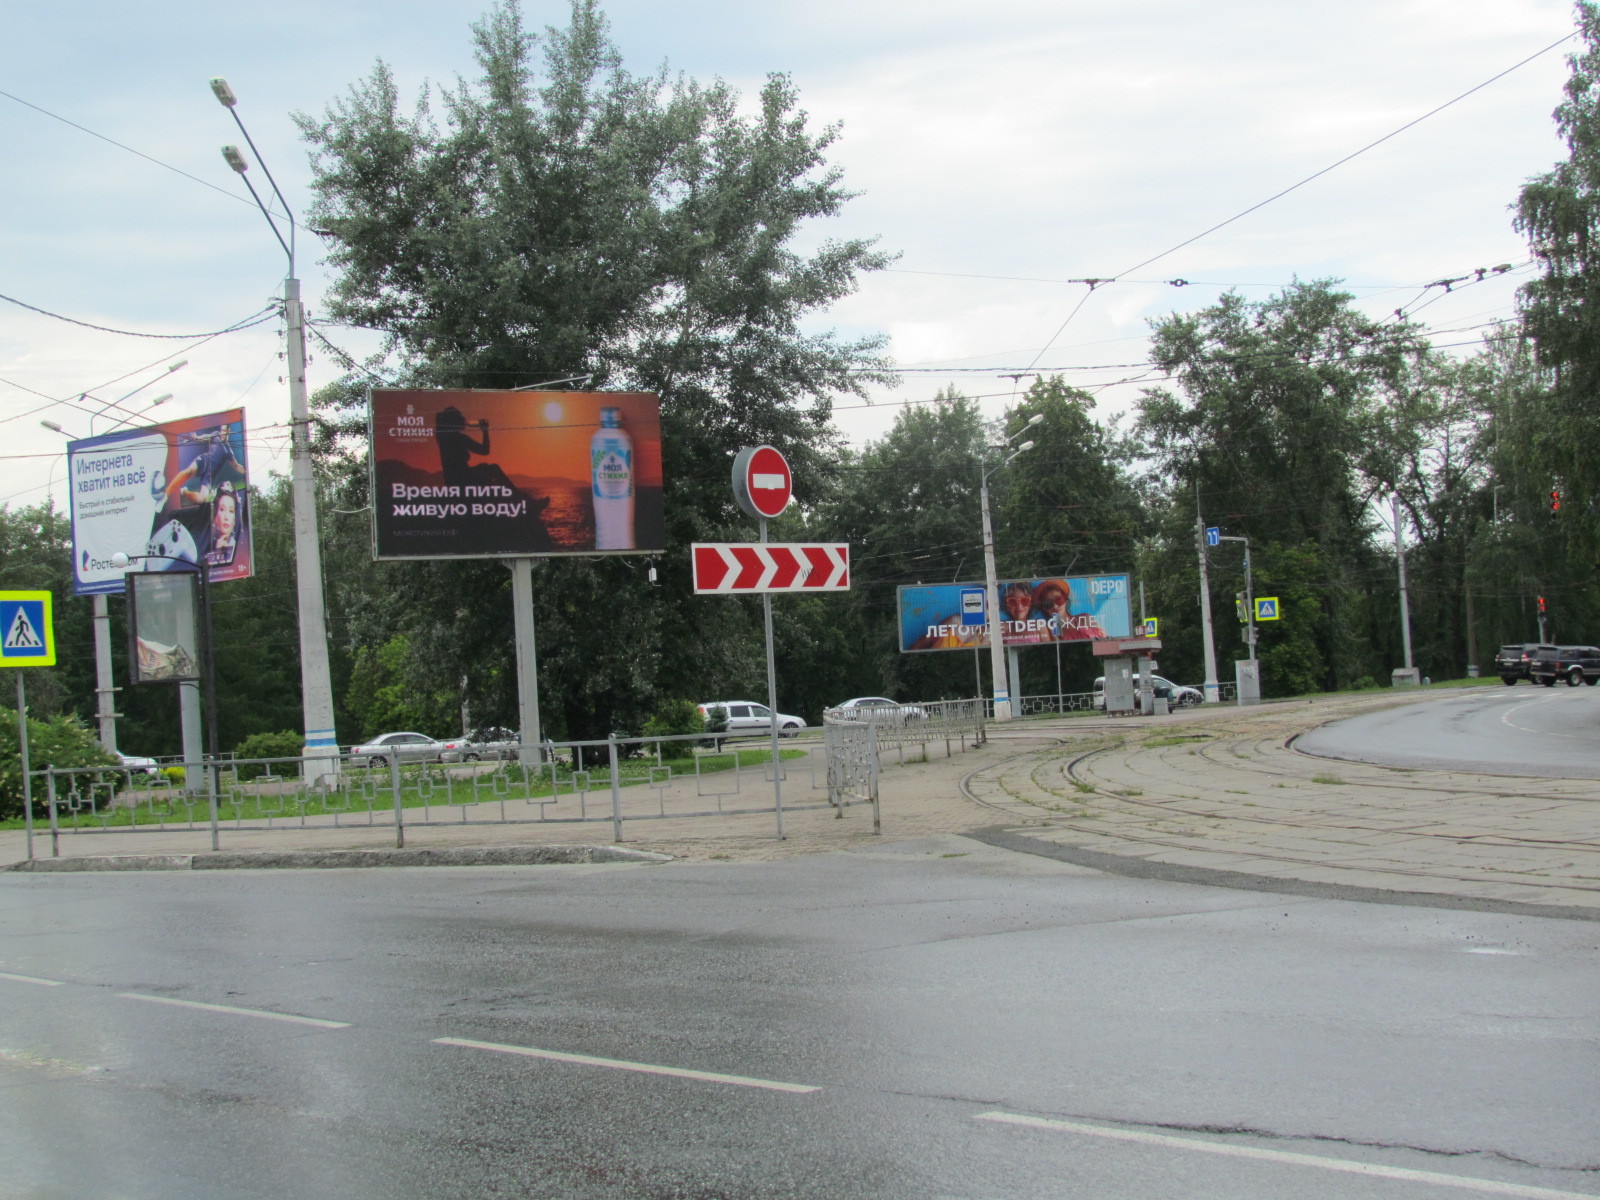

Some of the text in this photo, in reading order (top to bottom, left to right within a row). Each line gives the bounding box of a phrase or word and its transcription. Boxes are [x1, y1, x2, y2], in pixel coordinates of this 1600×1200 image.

[397, 416, 424, 426] МОЯ
[389, 427, 434, 437] СТИХИЯ
[77, 454, 133, 475] Интернета
[78, 467, 146, 493] хватит на всё
[599, 472, 628, 480] СТИХИЯ
[392, 483, 513, 501] Время пить
[392, 499, 527, 519] живую воду!
[91, 558, 138, 570] Ростеом
[238, 564, 247, 572] 18+
[1091, 580, 1123, 595] DEPO
